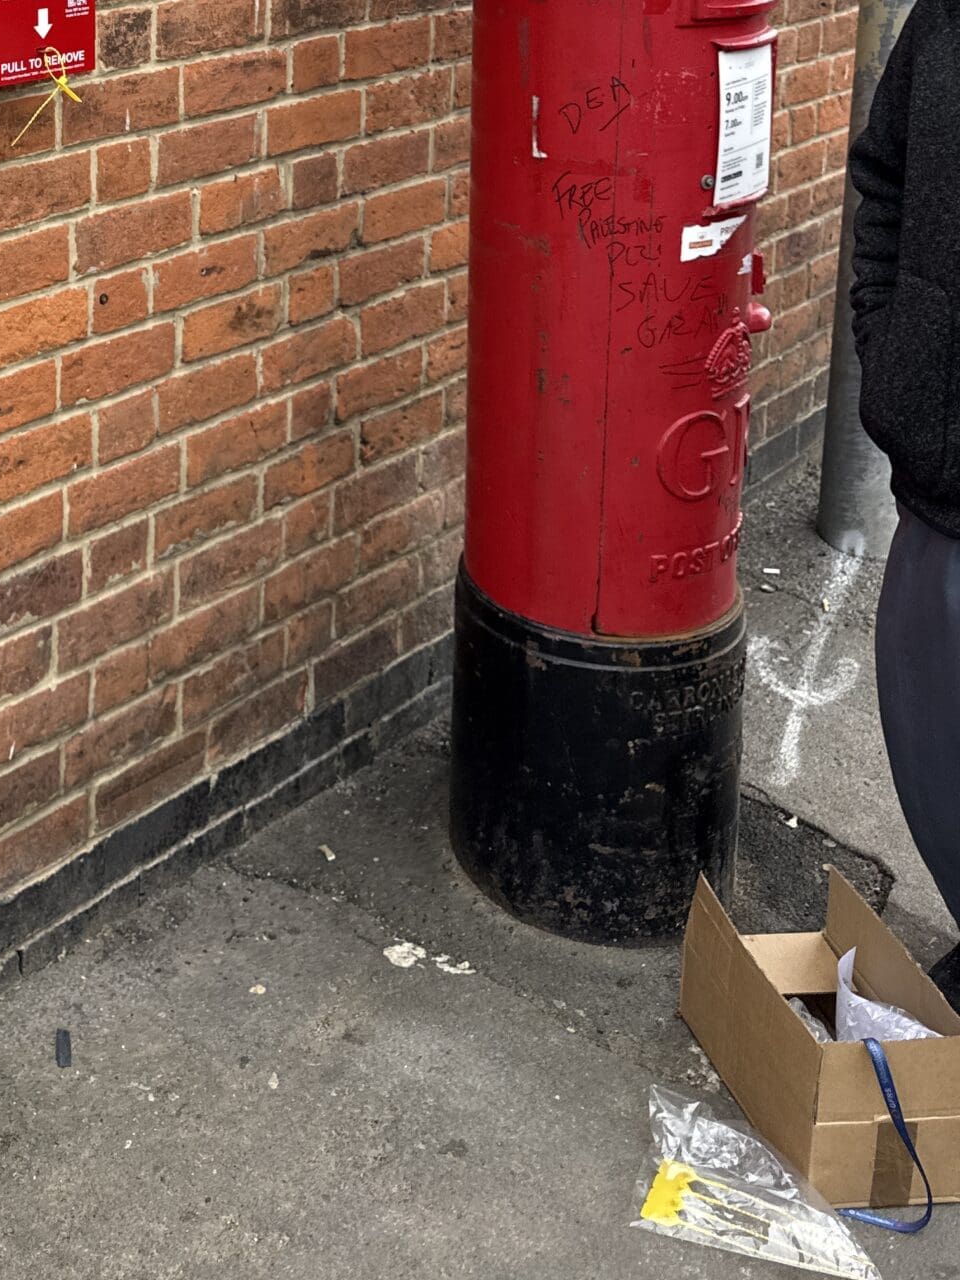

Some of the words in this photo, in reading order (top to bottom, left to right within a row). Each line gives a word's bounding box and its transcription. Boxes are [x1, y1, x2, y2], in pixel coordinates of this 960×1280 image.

[0, 60, 28, 75] PULL
[28, 57, 43, 70] TO
[552, 171, 611, 219] FREE
[616, 272, 719, 312] SAVE
[649, 541, 719, 583] POST
